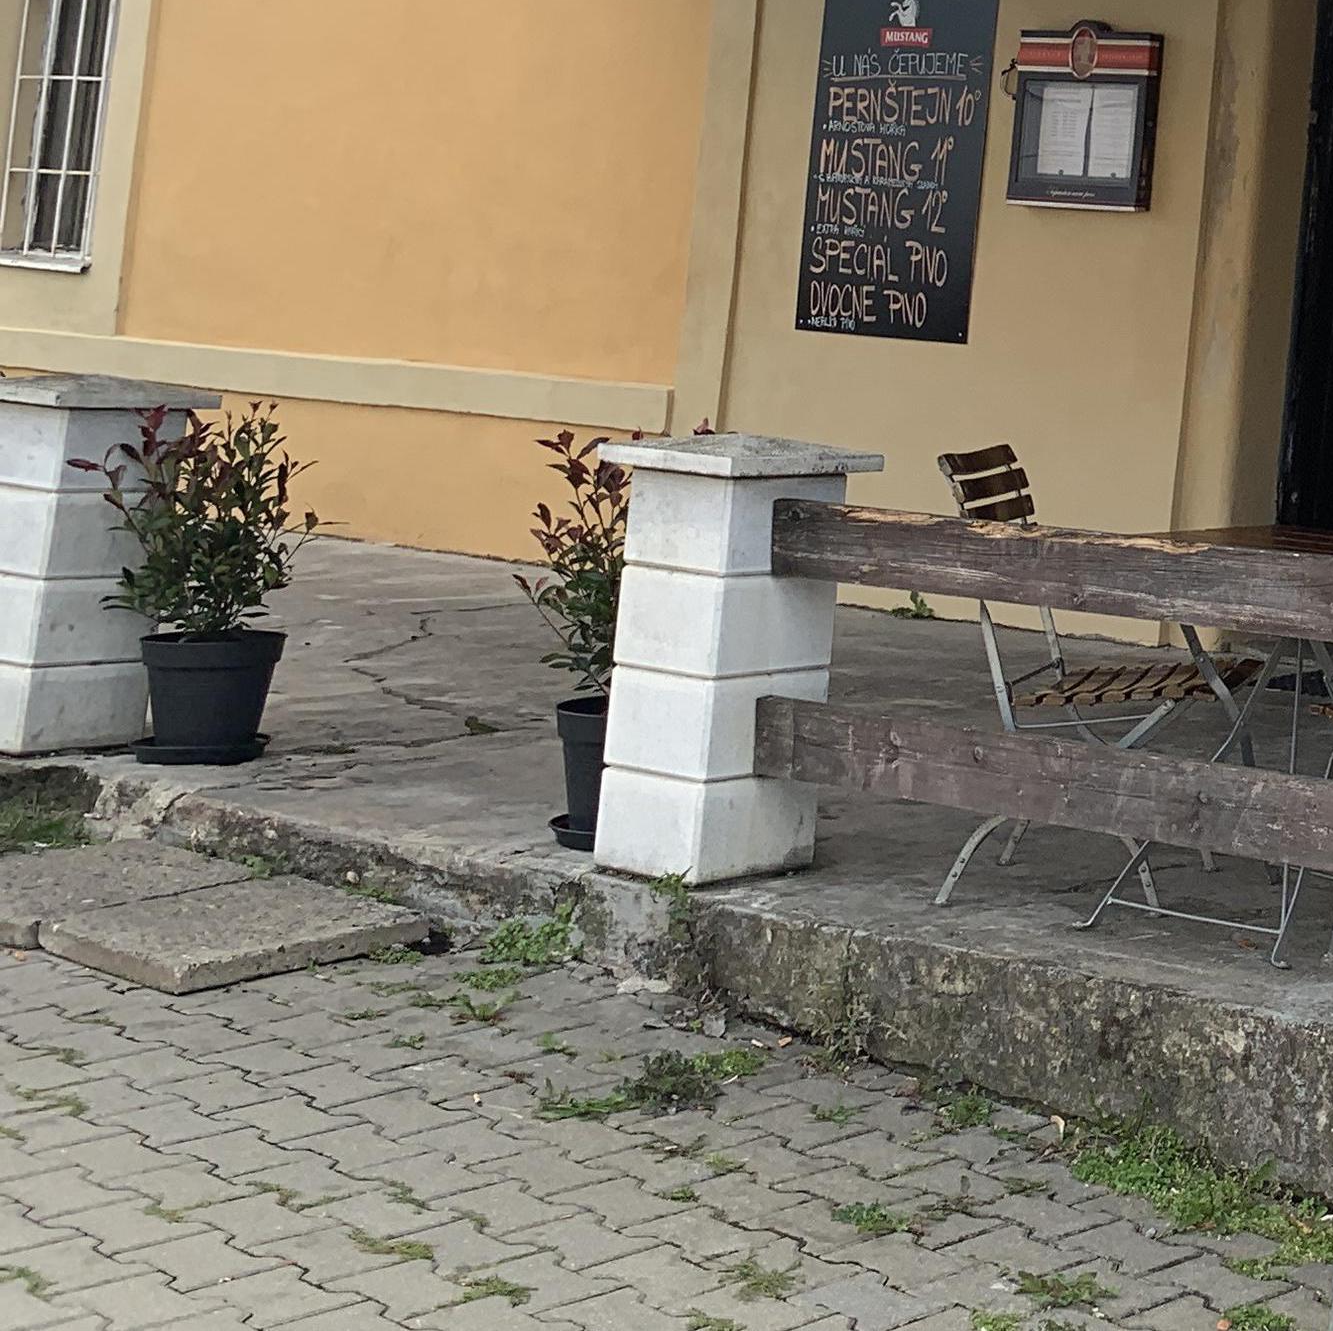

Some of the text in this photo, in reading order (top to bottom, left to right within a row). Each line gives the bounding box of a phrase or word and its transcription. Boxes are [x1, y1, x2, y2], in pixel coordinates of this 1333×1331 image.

[885, 30, 929, 44] MUSTANG
[832, 47, 969, 77] U NÁS ČEPUJEME
[828, 79, 952, 127] PERNŠTEJN
[819, 137, 923, 182] MUSTANG
[816, 184, 915, 230] MUSTANG
[810, 234, 947, 287] SPECIÁL PIVO
[883, 290, 927, 328] PIVO
